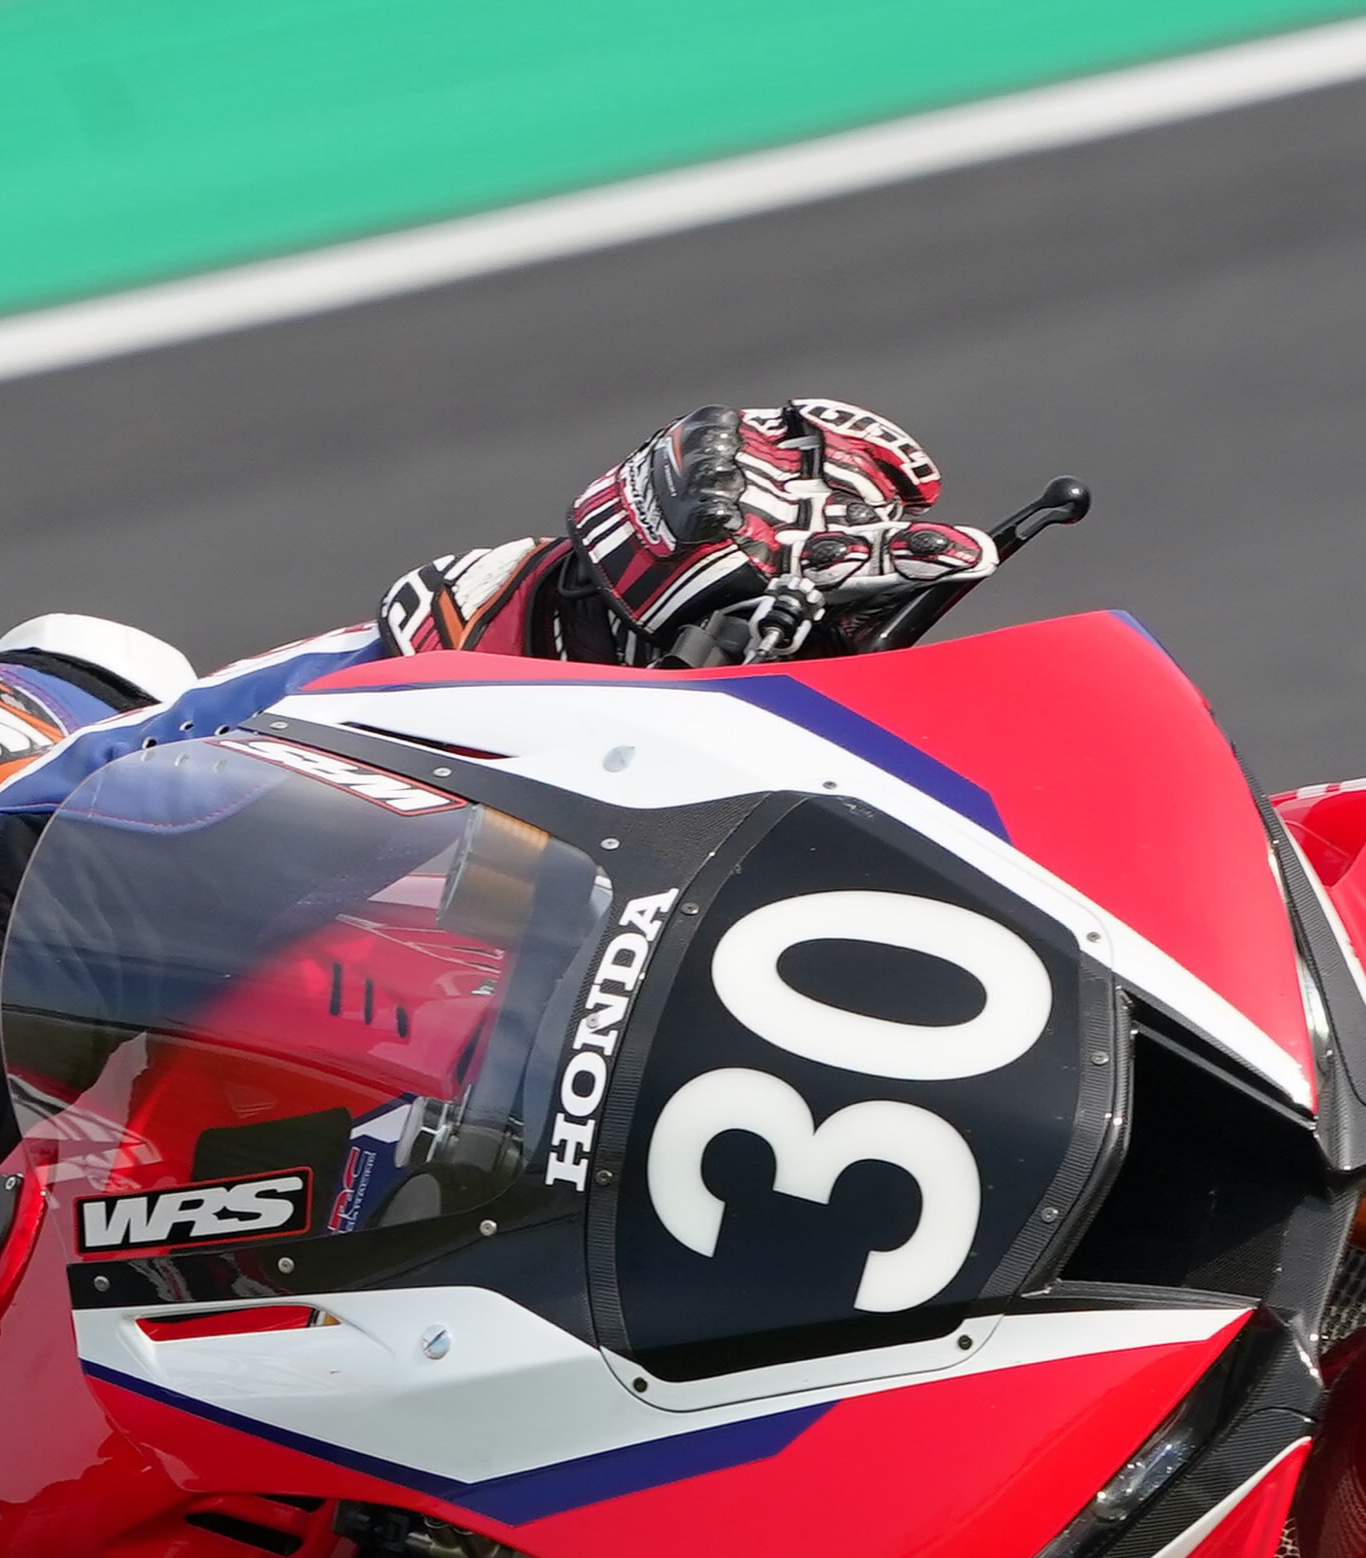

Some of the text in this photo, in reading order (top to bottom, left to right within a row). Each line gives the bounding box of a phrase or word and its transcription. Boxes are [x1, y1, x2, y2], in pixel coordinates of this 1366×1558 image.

[546, 888, 678, 1191] HONDA
[647, 890, 1053, 1313] 30
[82, 1176, 304, 1248] WRS
